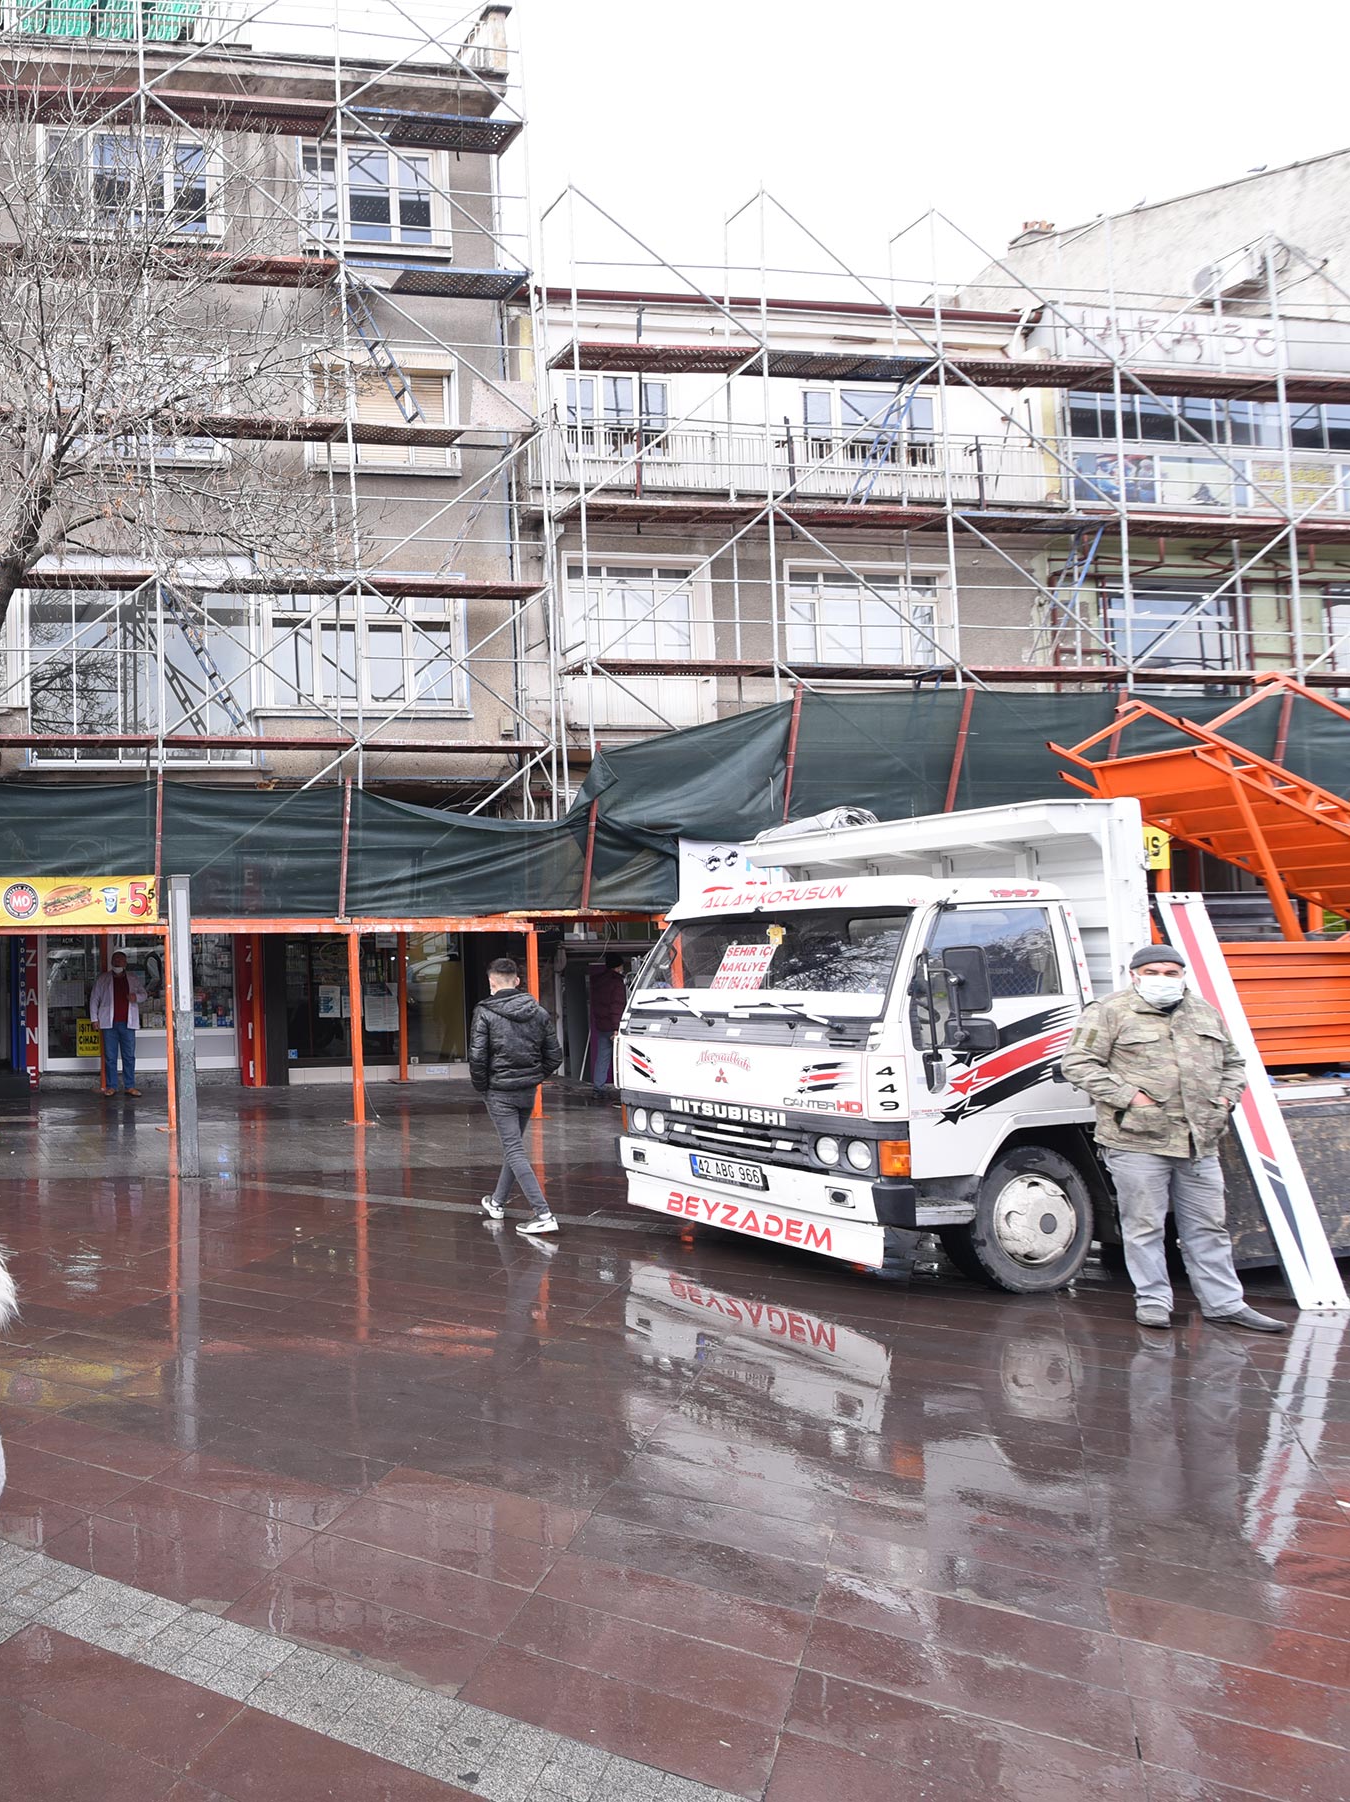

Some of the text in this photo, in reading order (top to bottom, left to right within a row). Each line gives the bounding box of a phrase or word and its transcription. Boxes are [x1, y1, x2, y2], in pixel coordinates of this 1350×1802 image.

[12, 895, 31, 908] MD
[701, 884, 848, 909] ALLAH KORUSUN
[989, 889, 1040, 898] 1997
[719, 962, 767, 972] NAKLİYE
[670, 1098, 787, 1127] MITSUBISHI
[698, 1159, 711, 1174] 42
[715, 1162, 735, 1179] ABG
[738, 1167, 760, 1184] 966
[666, 1191, 832, 1251] BEYZADEM
